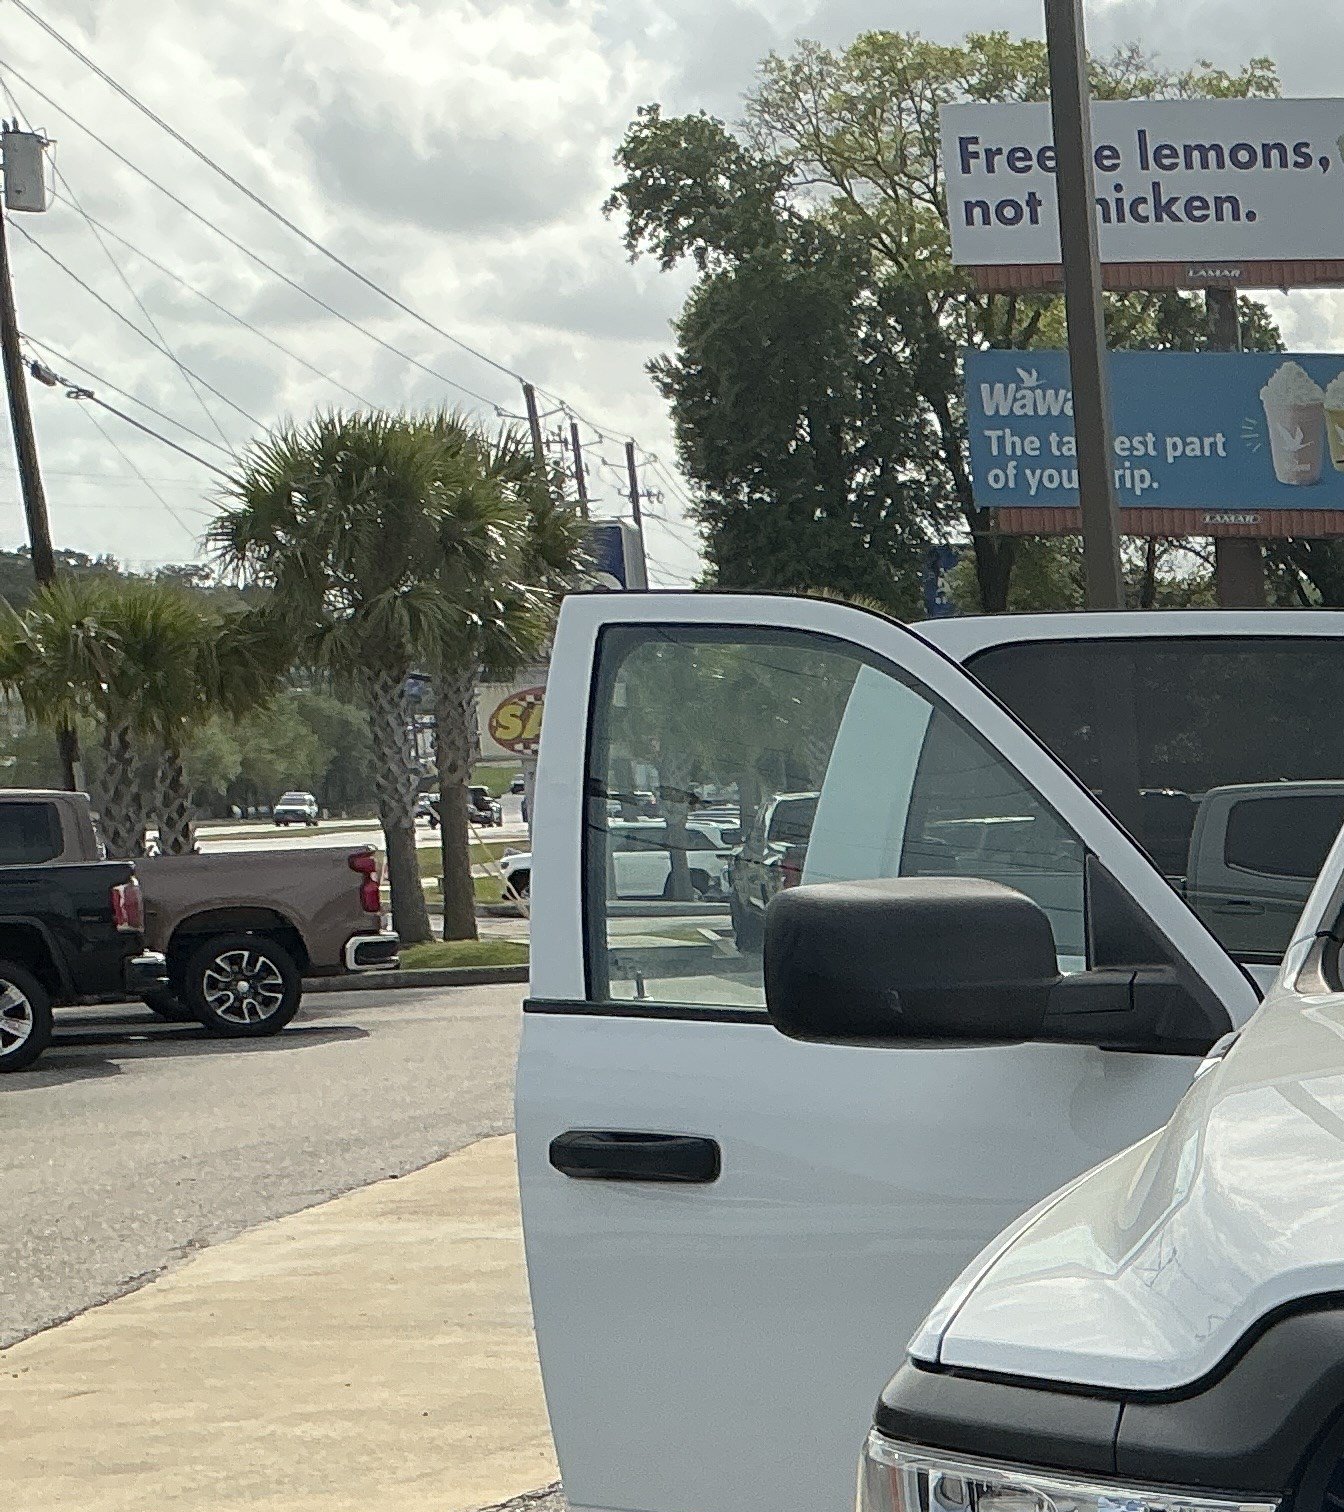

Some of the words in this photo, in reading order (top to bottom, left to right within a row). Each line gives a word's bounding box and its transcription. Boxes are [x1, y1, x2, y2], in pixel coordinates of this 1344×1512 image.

[958, 136, 1121, 175] Freee
[1136, 129, 1331, 174] lemons,
[964, 192, 1042, 226] not
[984, 428, 1041, 457] The
[1049, 432, 1157, 457] taest
[1165, 432, 1227, 463] part
[987, 461, 1018, 489] of
[1025, 467, 1080, 496] you
[1114, 461, 1159, 496] rip.
